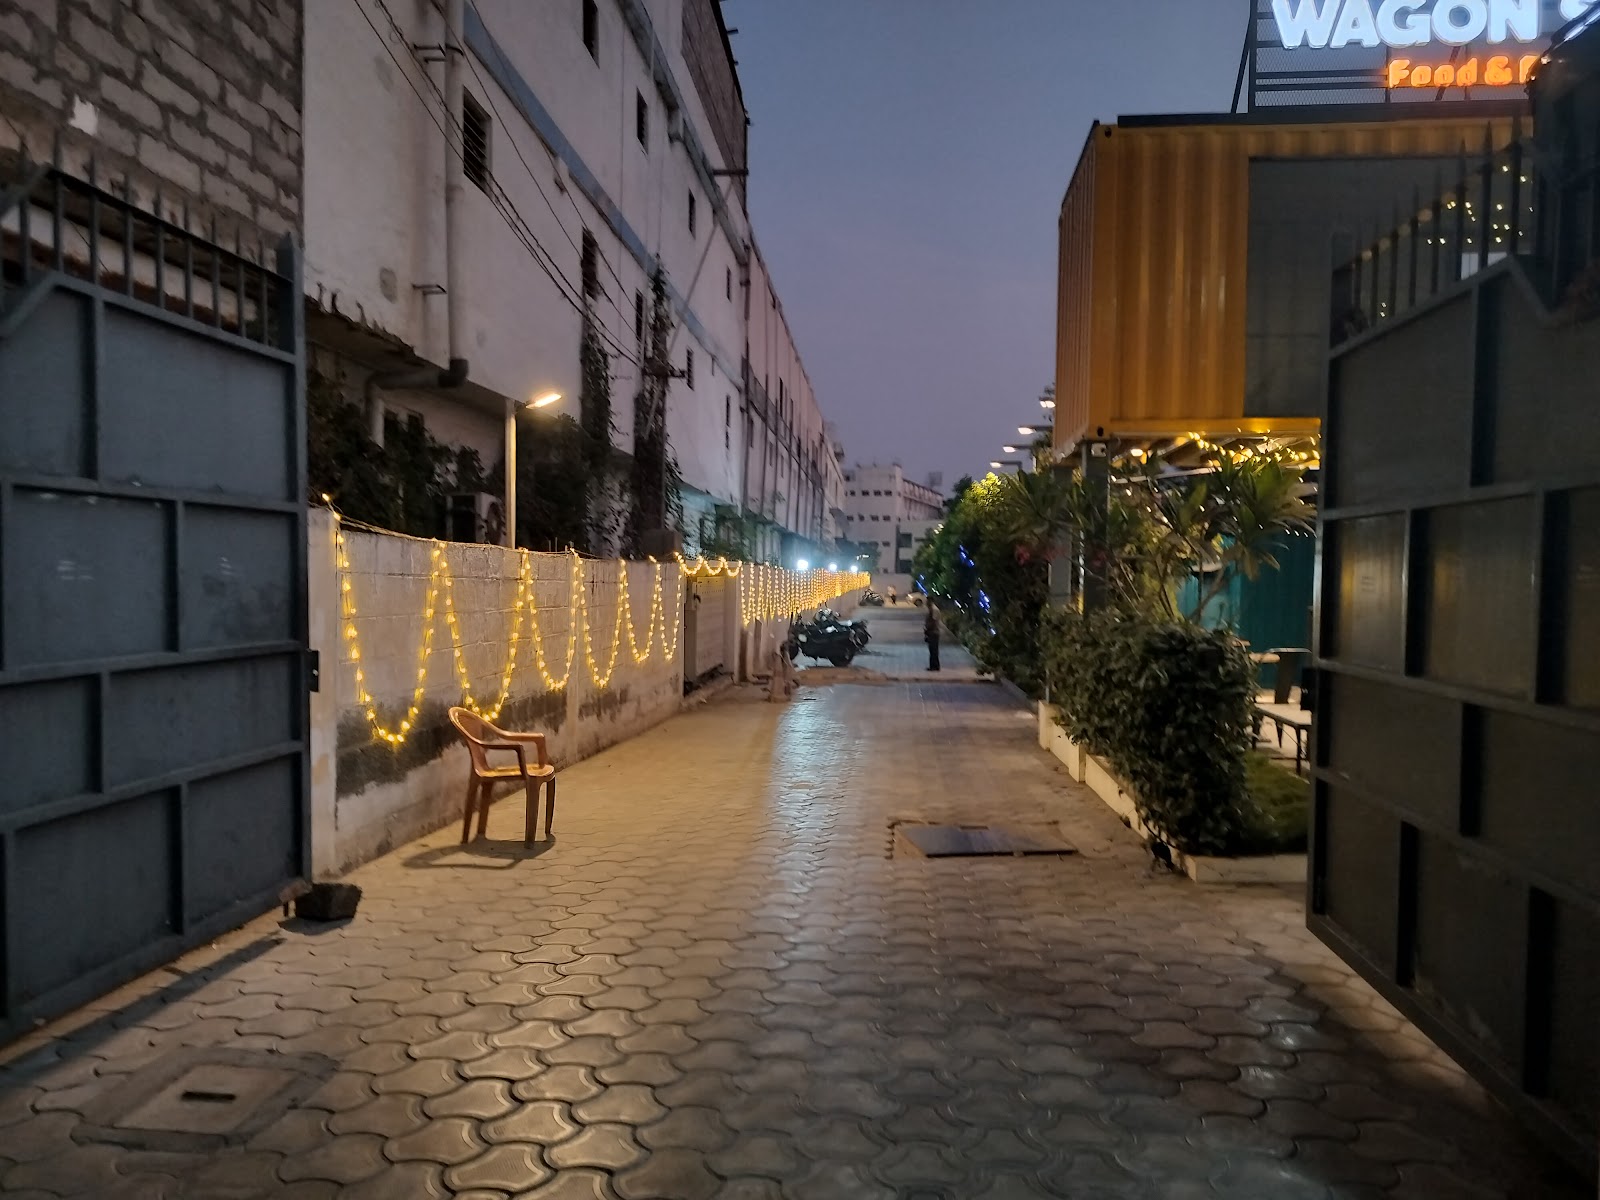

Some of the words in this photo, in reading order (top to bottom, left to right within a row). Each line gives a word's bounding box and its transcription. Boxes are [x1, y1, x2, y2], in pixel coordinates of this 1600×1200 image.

[1272, 0, 1539, 49] WAGON
[1389, 57, 1478, 88] Food
[1484, 55, 1513, 86] &
